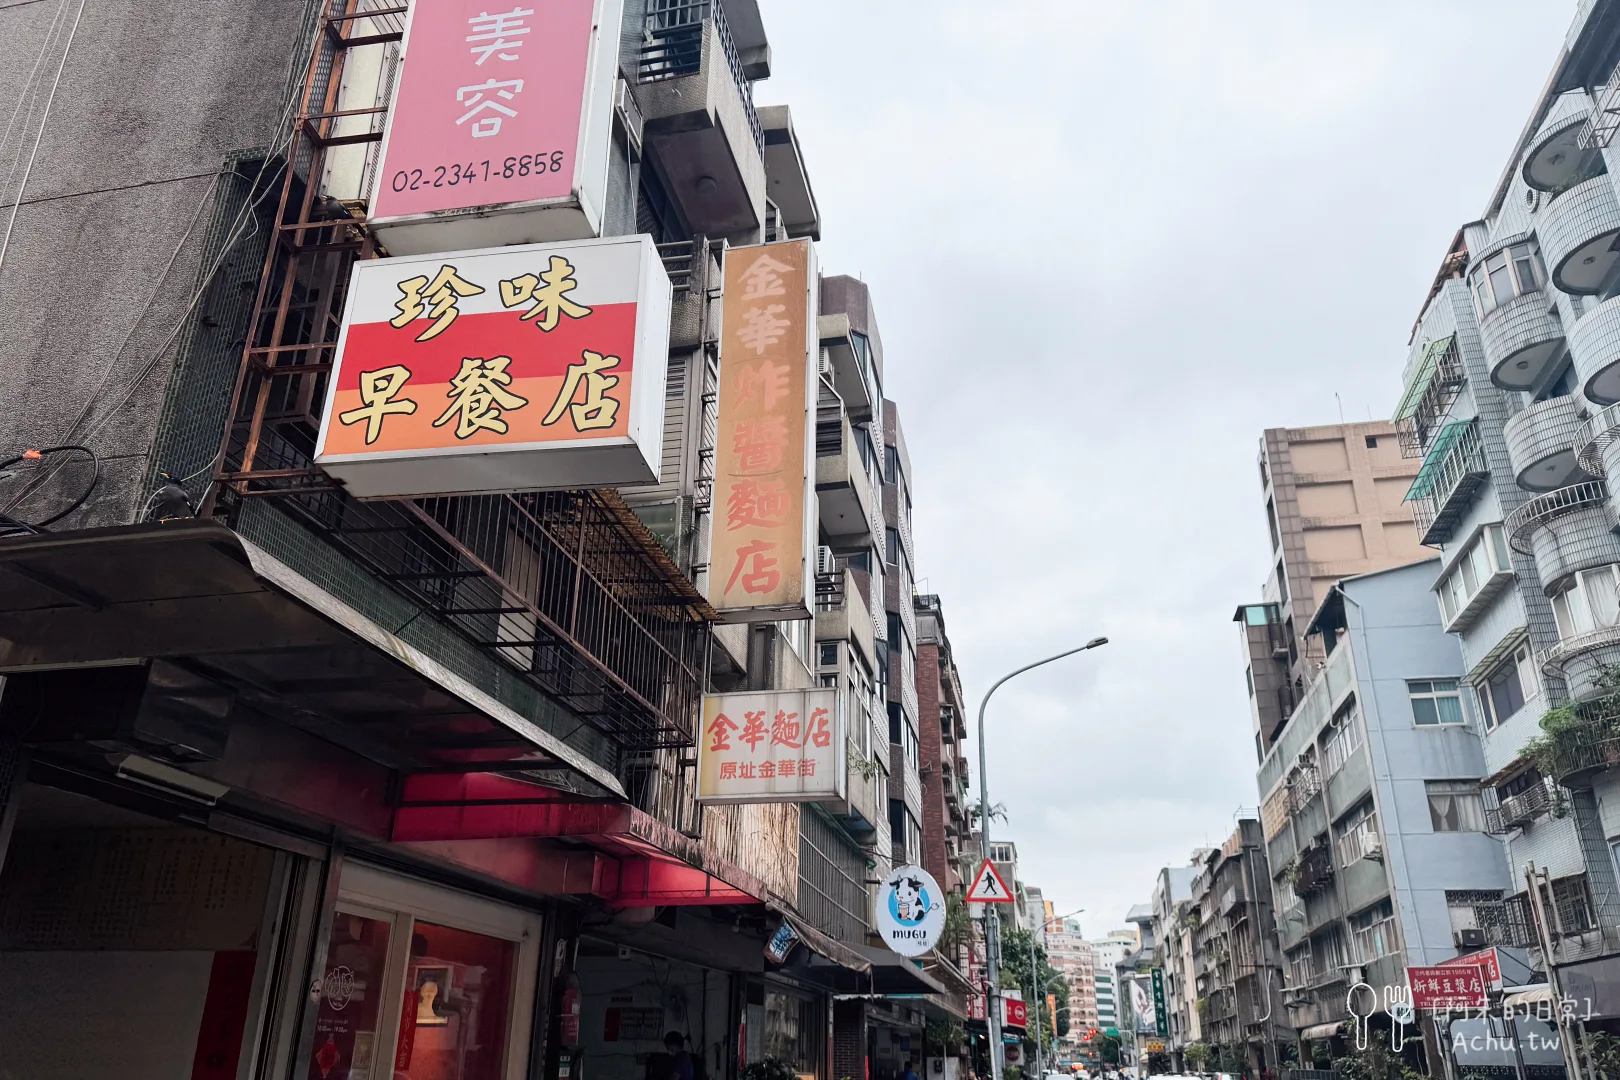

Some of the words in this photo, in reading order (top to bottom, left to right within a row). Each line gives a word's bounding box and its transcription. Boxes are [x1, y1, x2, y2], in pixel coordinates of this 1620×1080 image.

[455, 7, 534, 138] 美容
[392, 150, 564, 193] 02-2341-8858
[389, 255, 592, 343] 珍味
[339, 350, 624, 446] 早餐店
[707, 707, 830, 753] 金華麵店
[719, 758, 816, 780] 原址金華街
[1413, 977, 1482, 994] 新鮮豆漿店
